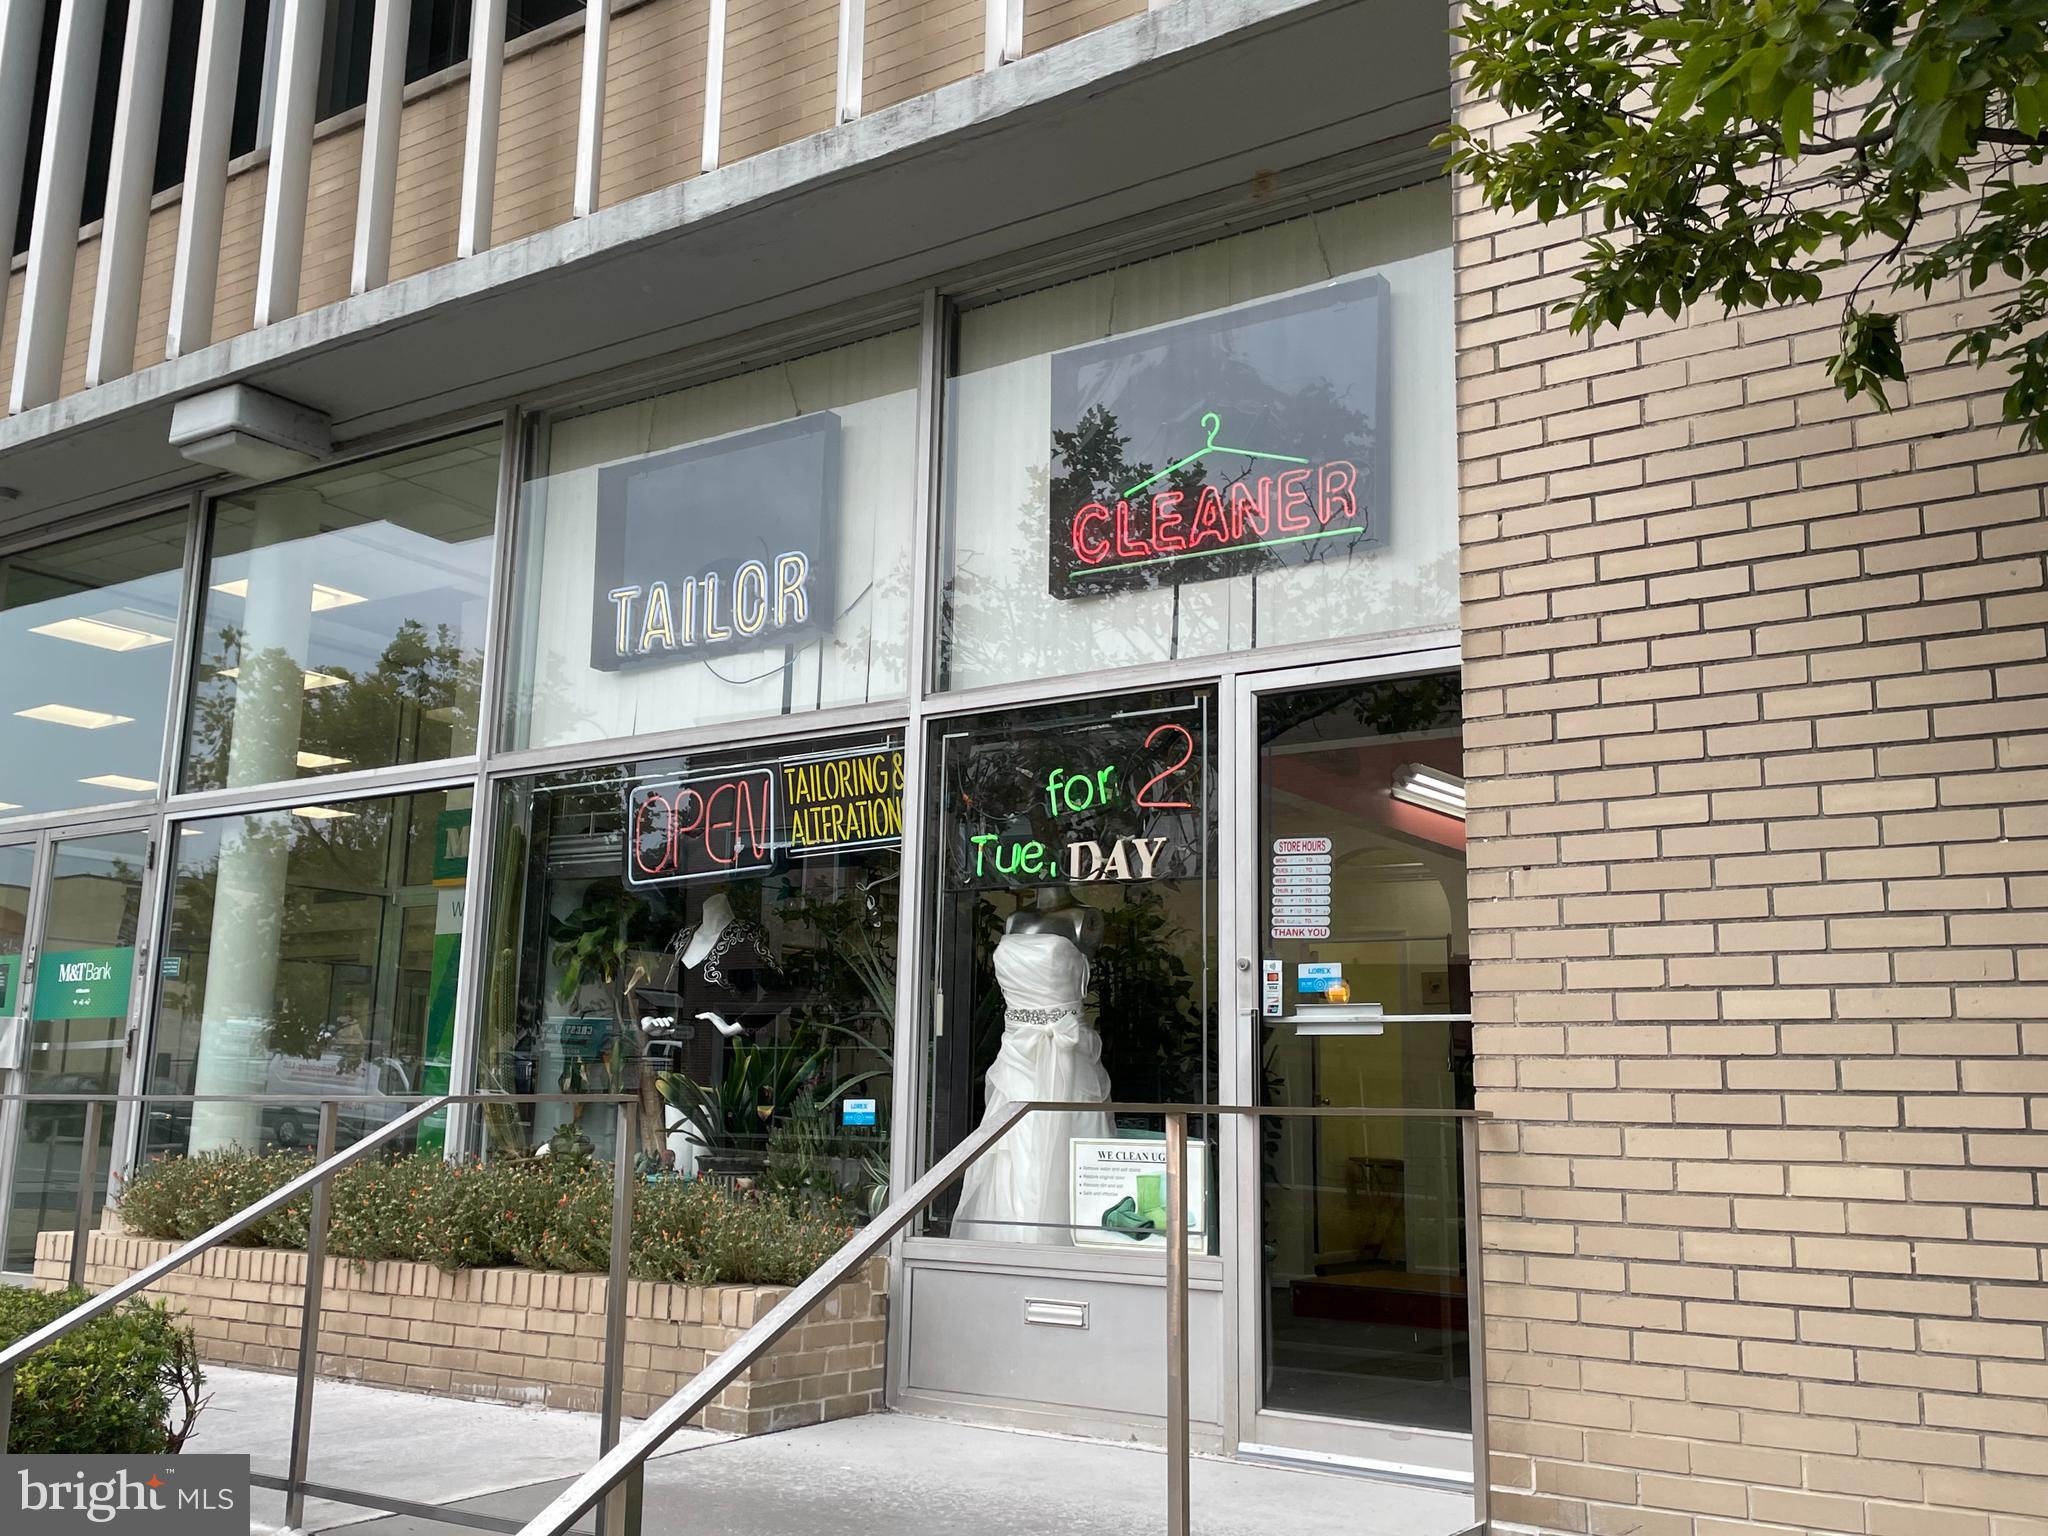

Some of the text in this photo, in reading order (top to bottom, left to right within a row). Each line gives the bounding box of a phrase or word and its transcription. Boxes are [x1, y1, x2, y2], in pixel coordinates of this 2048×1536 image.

[1072, 460, 1359, 565] CLEANER
[608, 550, 809, 656] TAILOR
[784, 752, 904, 805] TAILORING &
[1046, 724, 1193, 816] for 2
[636, 779, 770, 873] OPEN
[791, 796, 904, 847] ALTERATION
[1279, 840, 1326, 852] STORE HOURS
[1067, 837, 1168, 882] DAY
[1274, 928, 1327, 937] THANK YOU
[58, 961, 112, 982] M&T Bank
[1098, 1151, 1167, 1162] WE CLEAN UG
